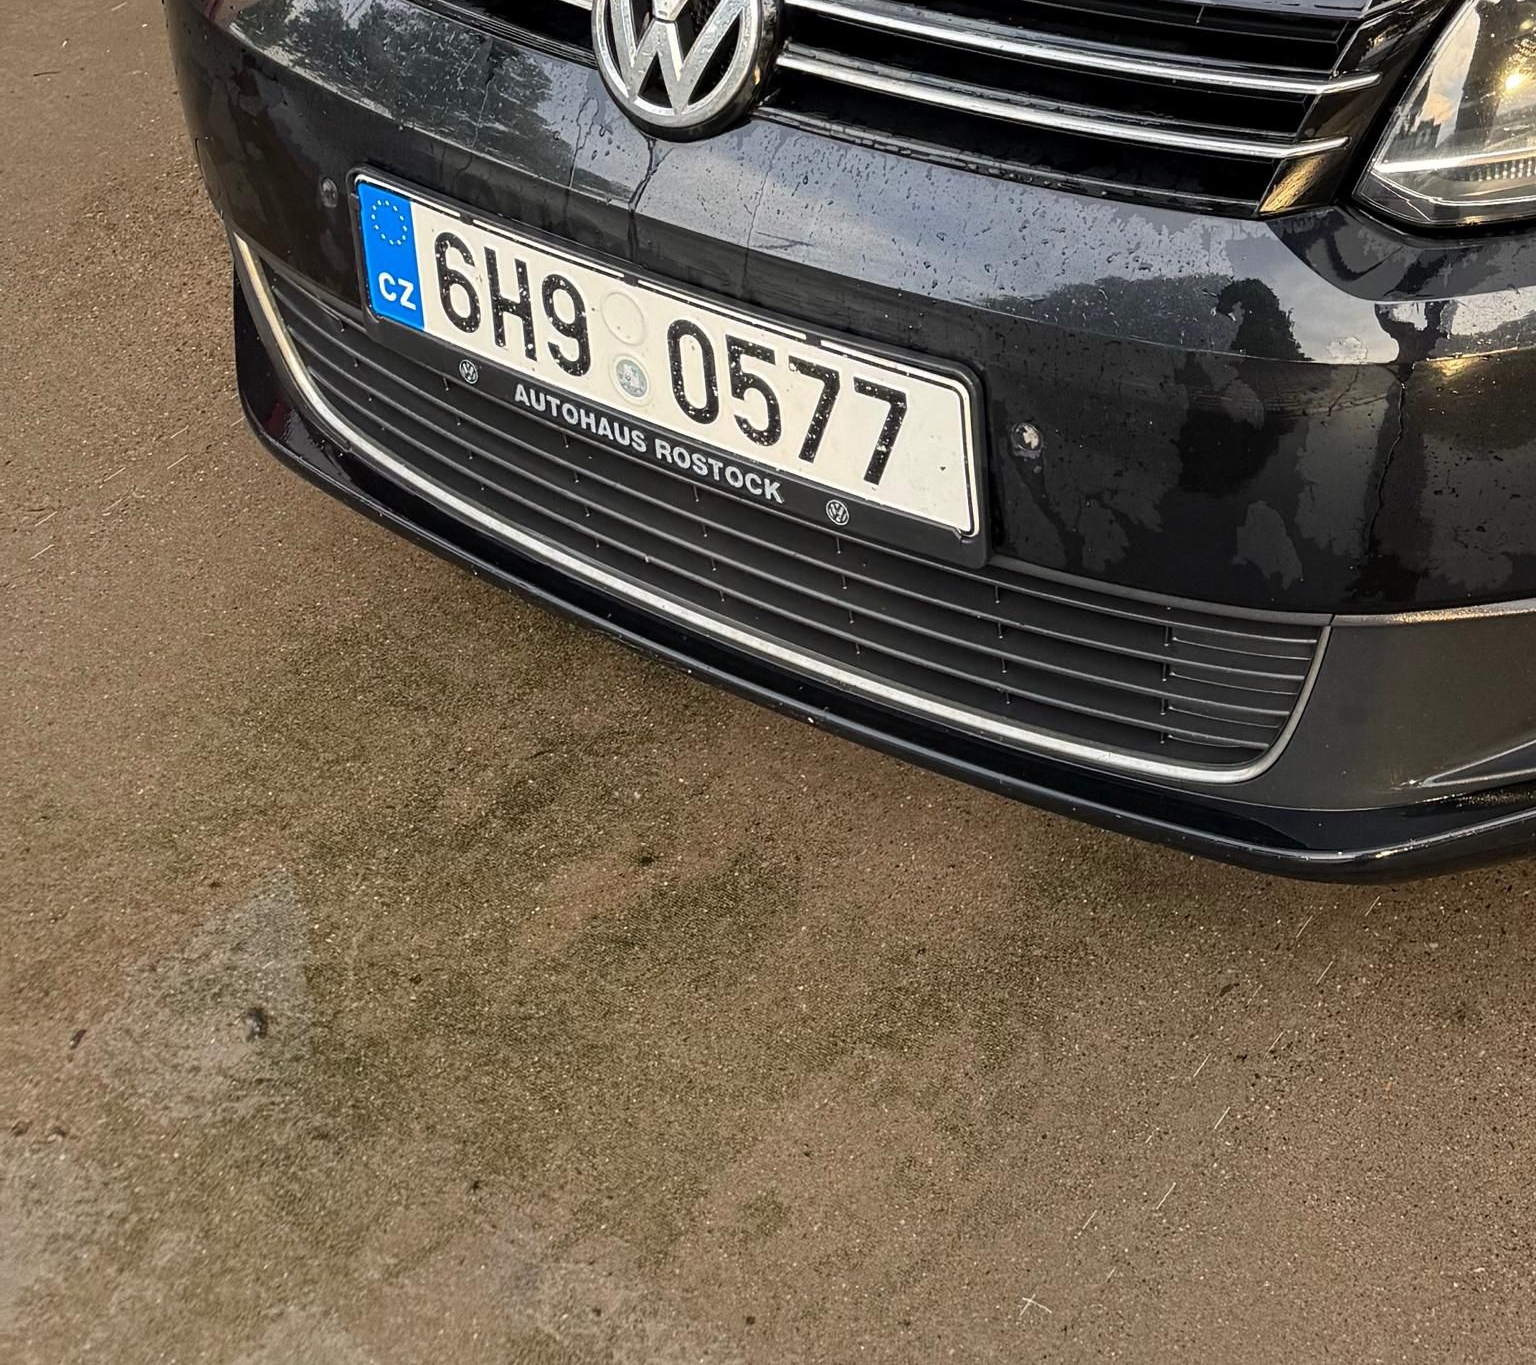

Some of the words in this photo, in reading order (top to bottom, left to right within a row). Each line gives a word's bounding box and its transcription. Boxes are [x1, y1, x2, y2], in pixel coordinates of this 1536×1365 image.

[378, 271, 417, 311] CZ
[435, 231, 592, 378] 6H9
[667, 318, 908, 486] 0577
[514, 383, 648, 453] AUTOHAUS
[654, 438, 785, 504] ROSTOCK
